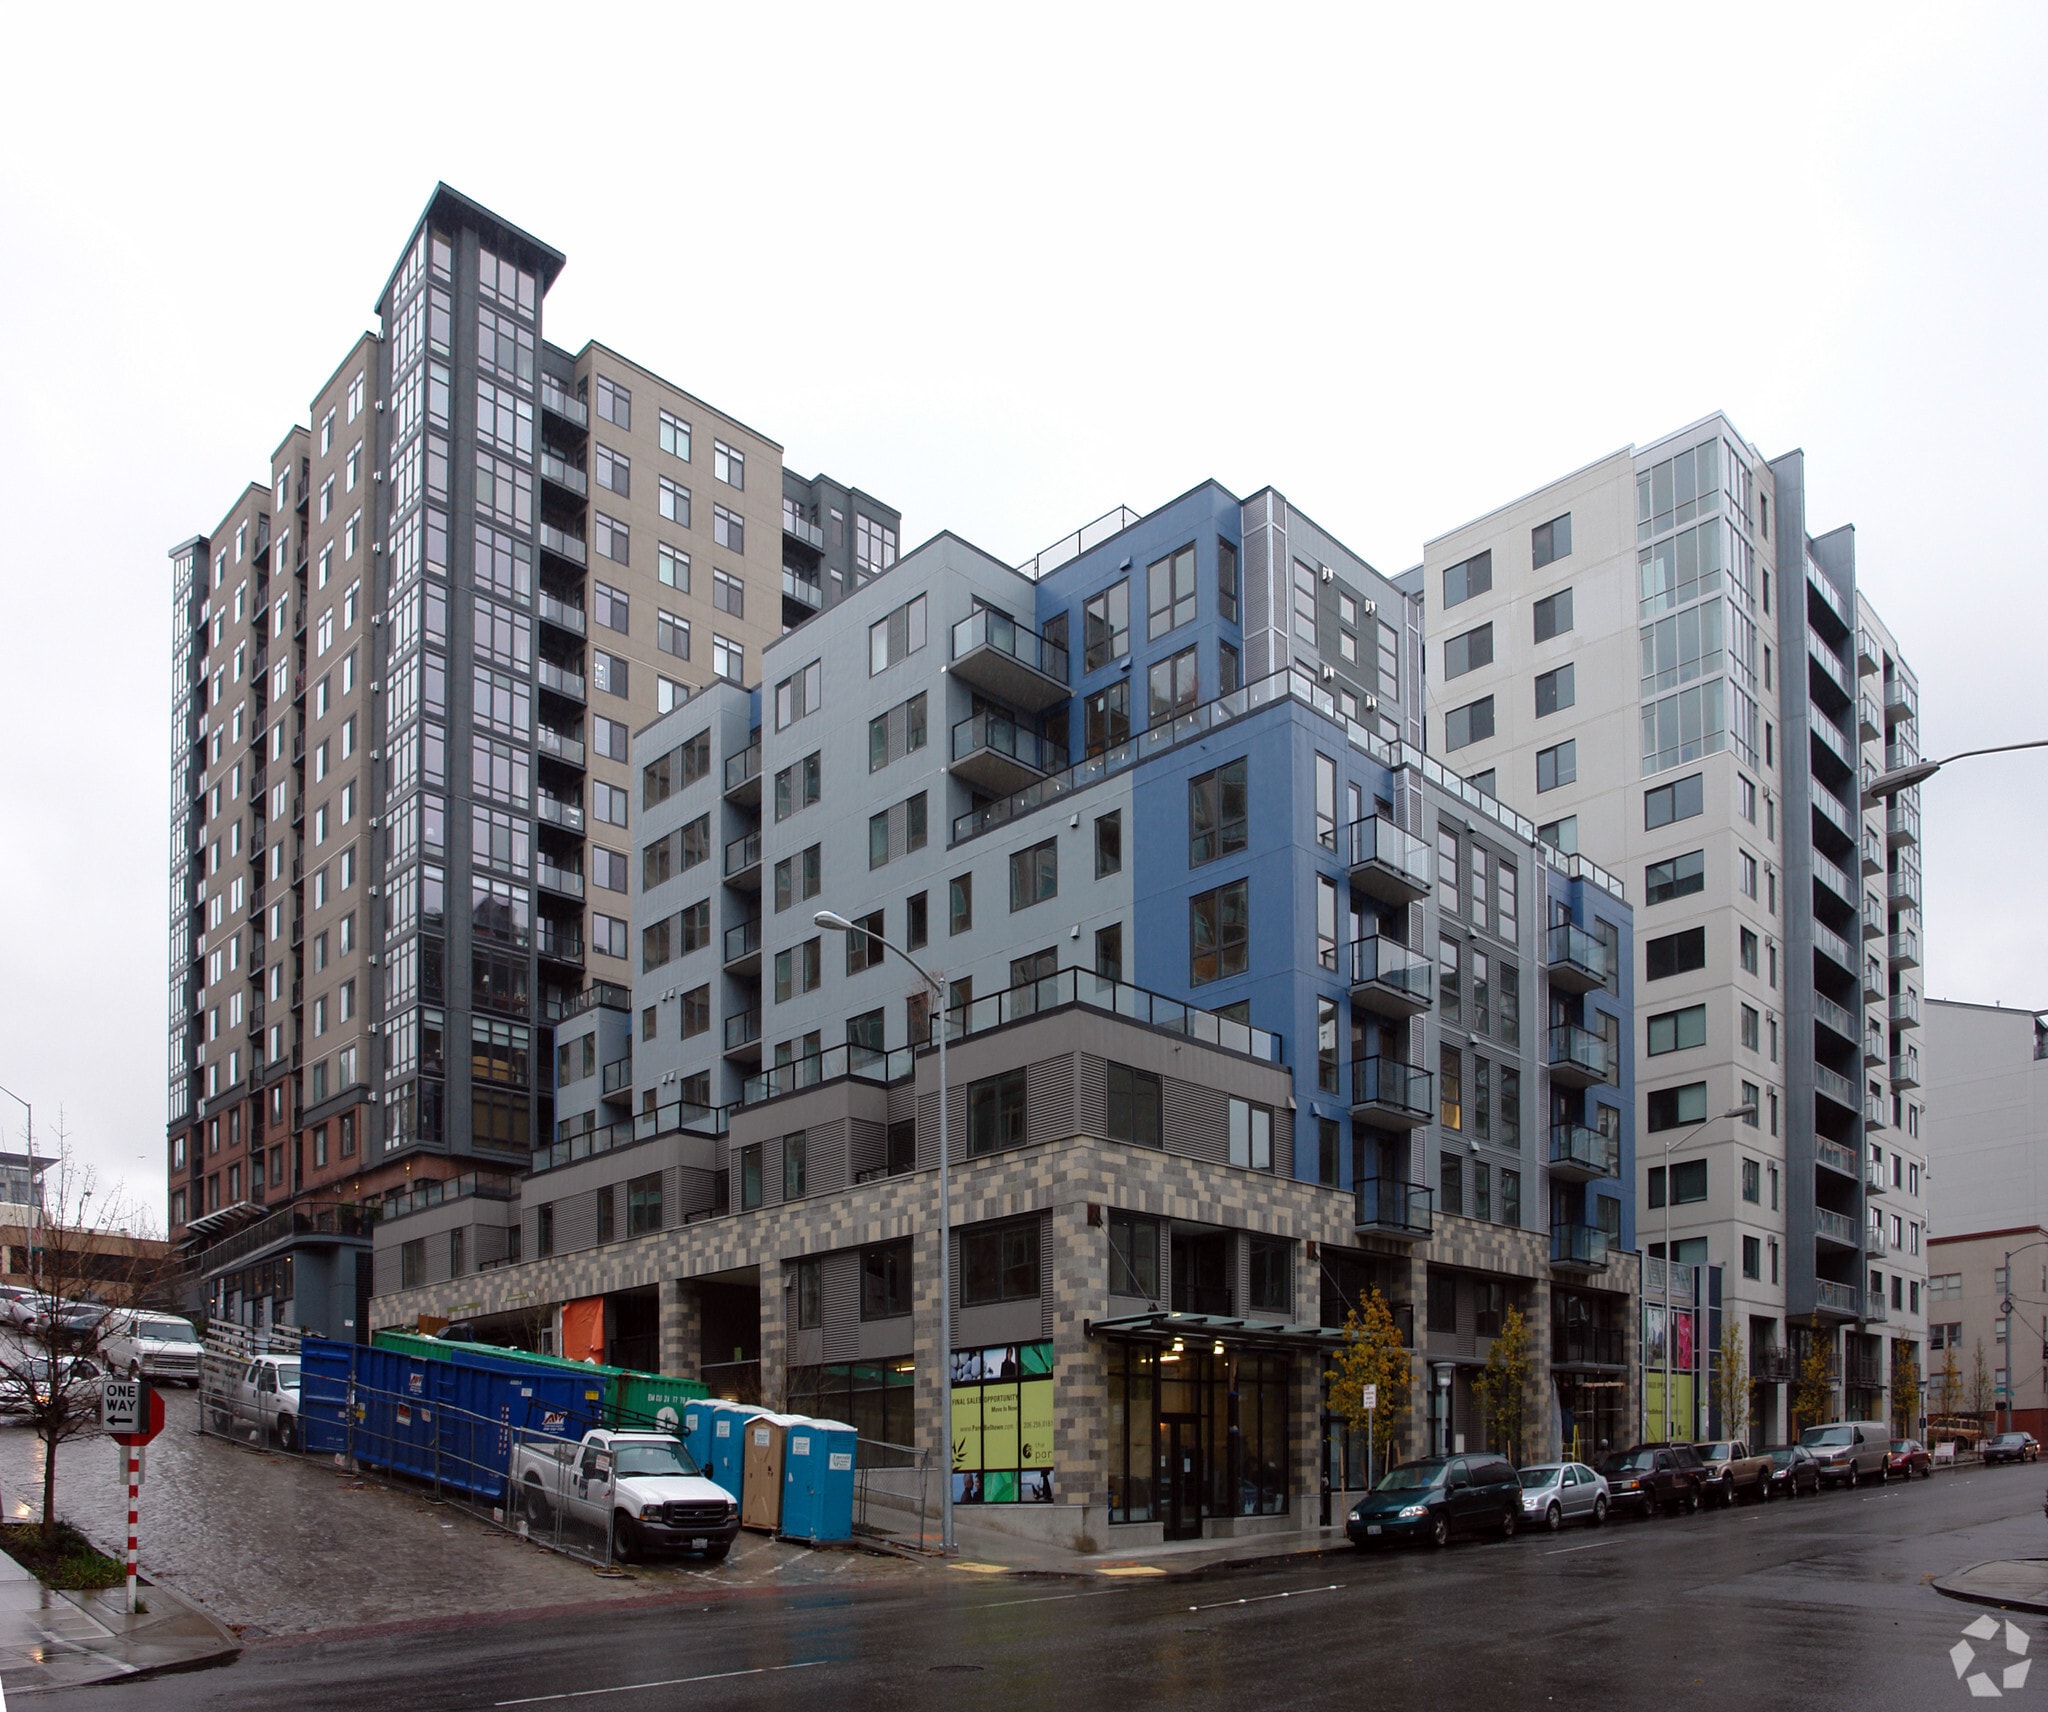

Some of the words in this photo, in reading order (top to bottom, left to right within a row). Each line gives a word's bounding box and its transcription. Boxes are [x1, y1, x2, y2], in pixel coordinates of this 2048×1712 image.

[107, 1385, 136, 1397] ONE
[106, 1399, 137, 1411] WAY
[952, 1398, 966, 1406] FINAL
[983, 1394, 1018, 1404] OPPORTUNITY
